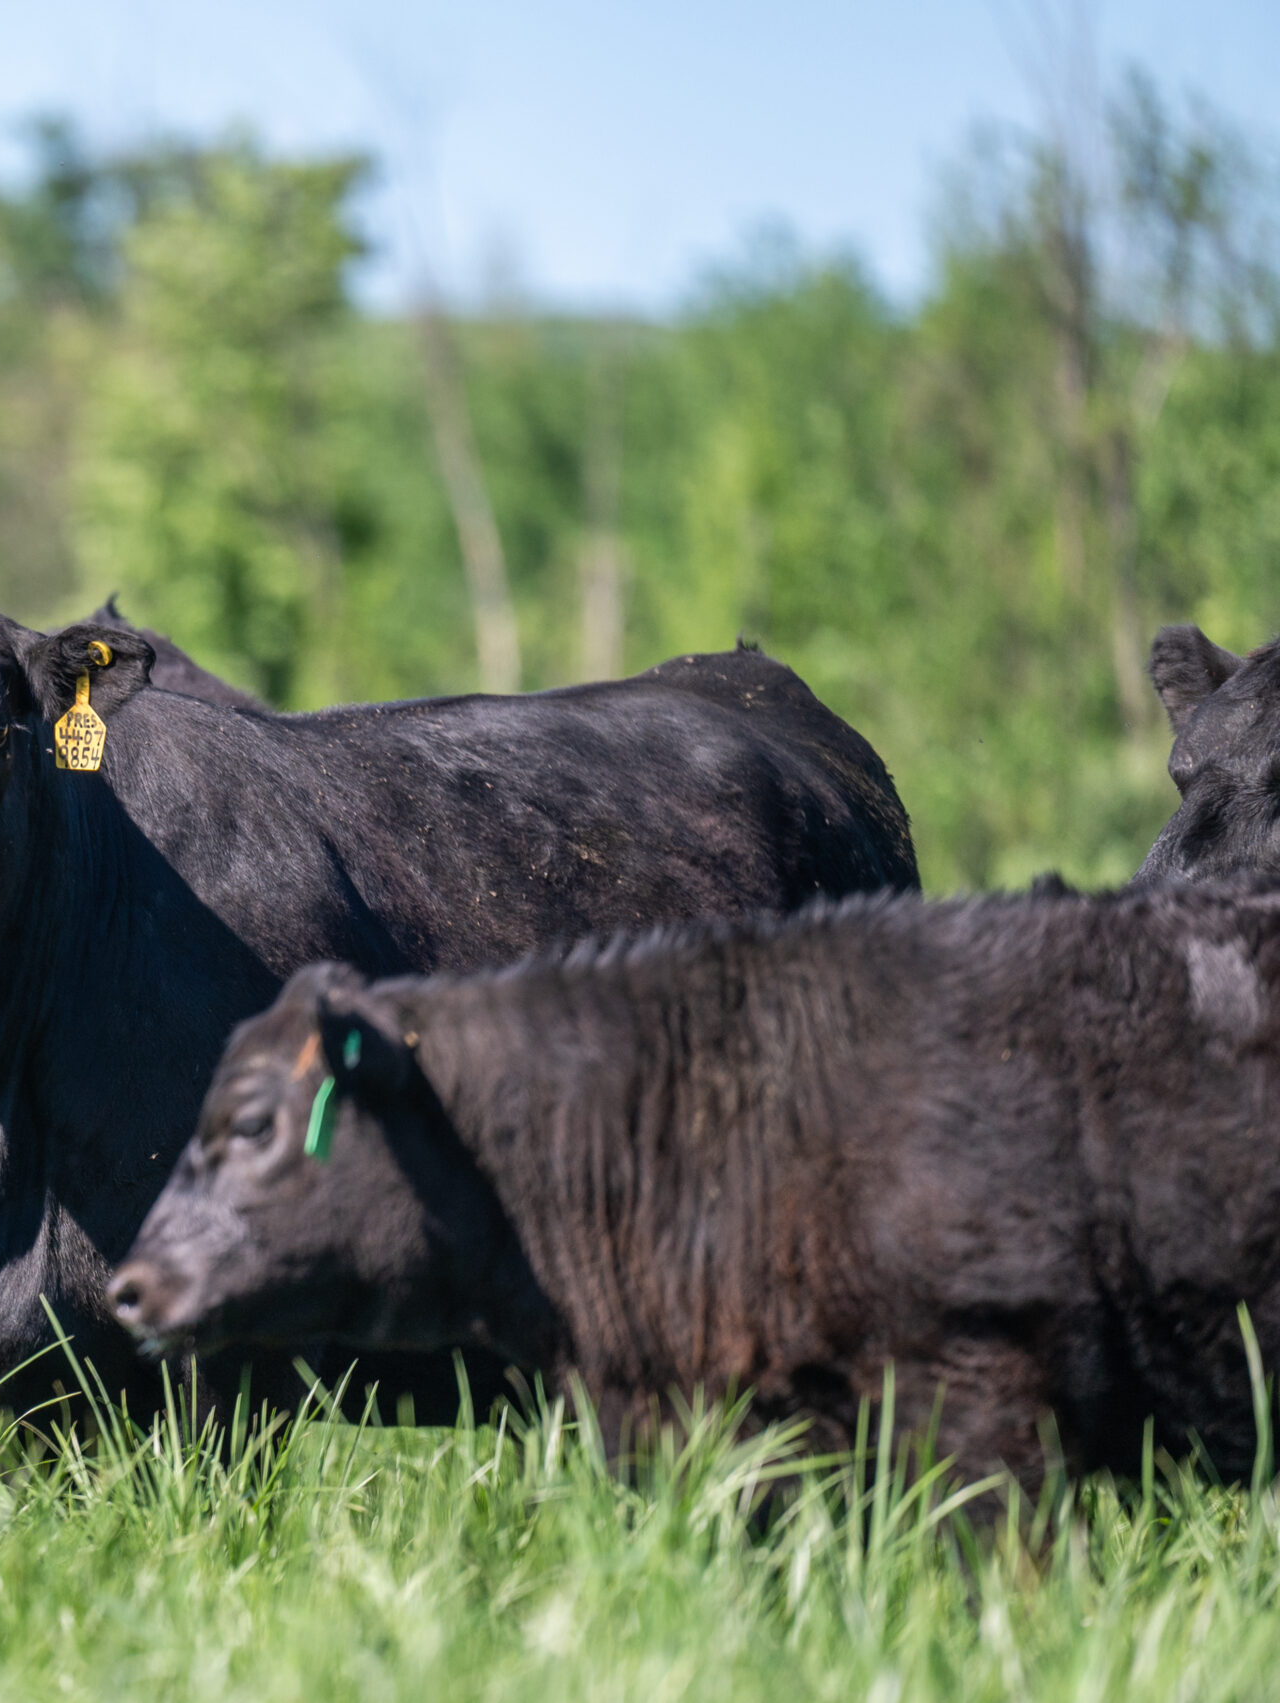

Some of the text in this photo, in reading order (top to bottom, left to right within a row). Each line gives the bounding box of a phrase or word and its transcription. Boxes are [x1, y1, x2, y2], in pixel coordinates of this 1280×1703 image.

[66, 712, 97, 728] PRES
[59, 728, 104, 746] 4407
[59, 745, 99, 769] 9854
